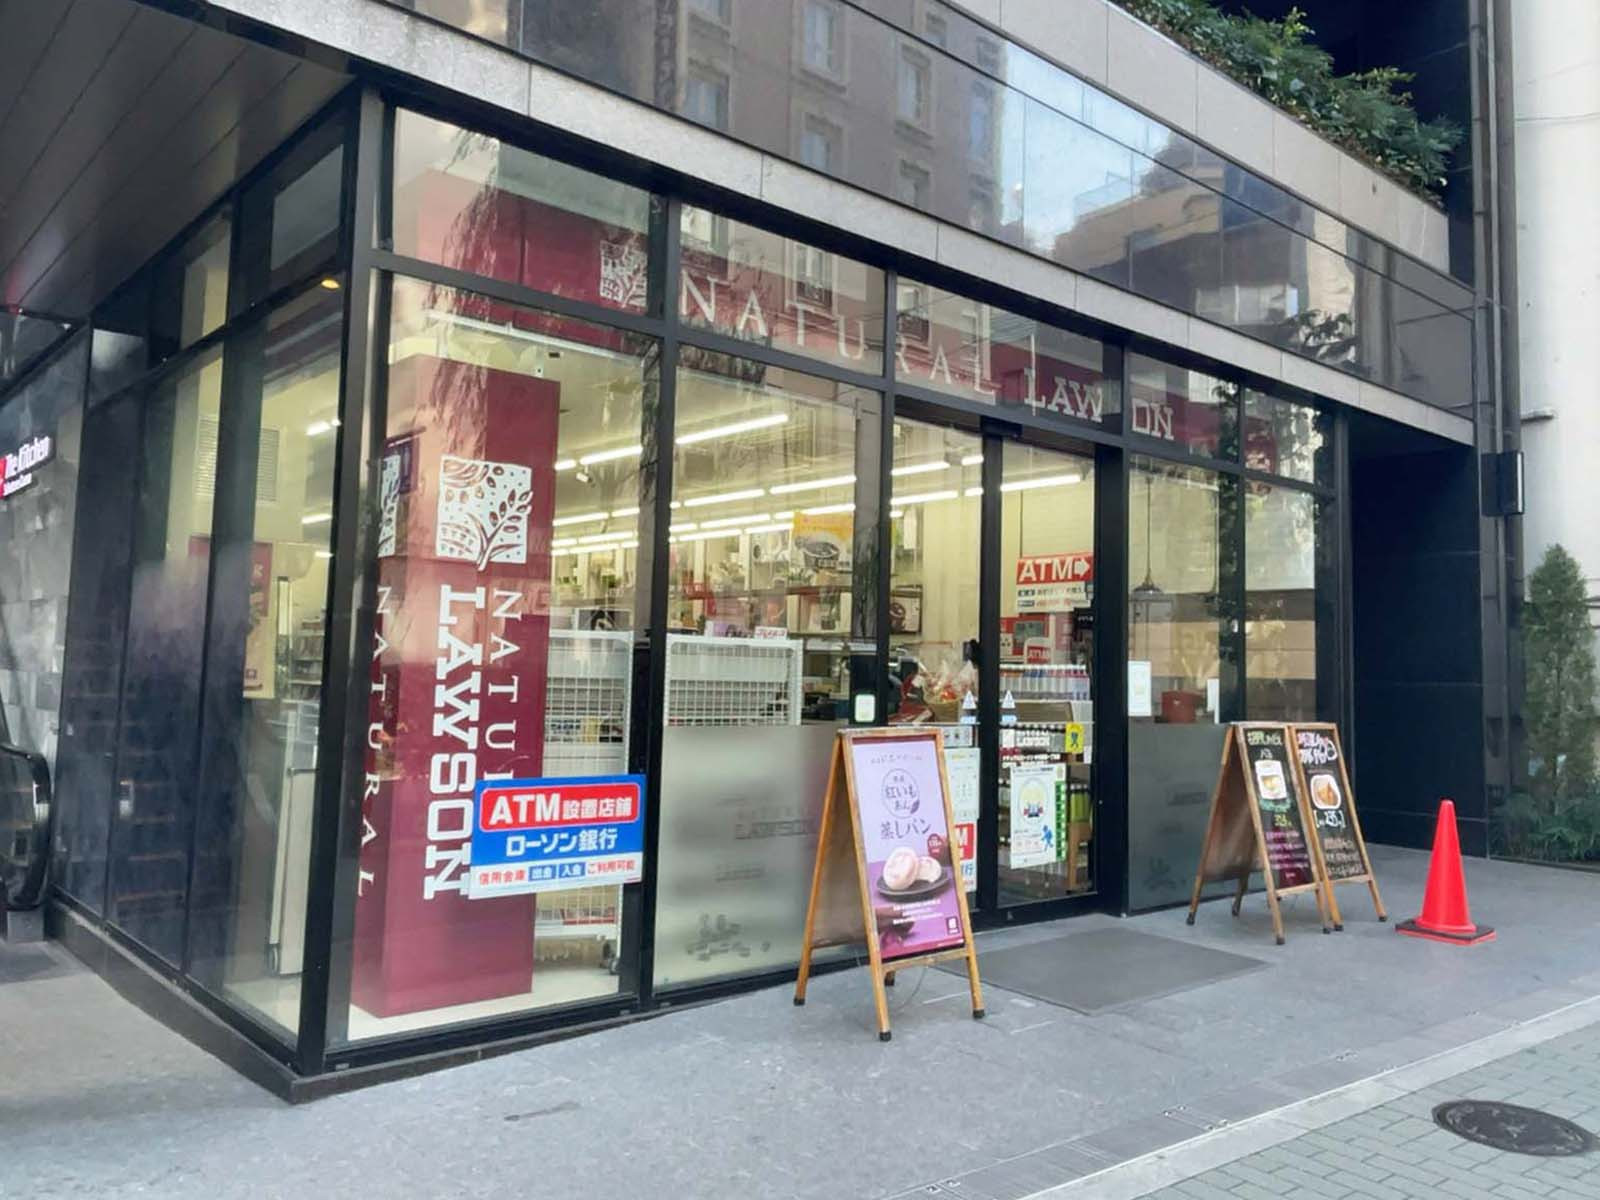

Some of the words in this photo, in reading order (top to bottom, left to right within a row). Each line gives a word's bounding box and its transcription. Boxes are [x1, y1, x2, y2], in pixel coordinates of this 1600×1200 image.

[1023, 366, 1174, 440] LAWON
[1018, 557, 1073, 582] ATM
[357, 585, 391, 897] NATURAL
[423, 584, 486, 899] LAWSON
[506, 828, 617, 857] ローソン銀行
